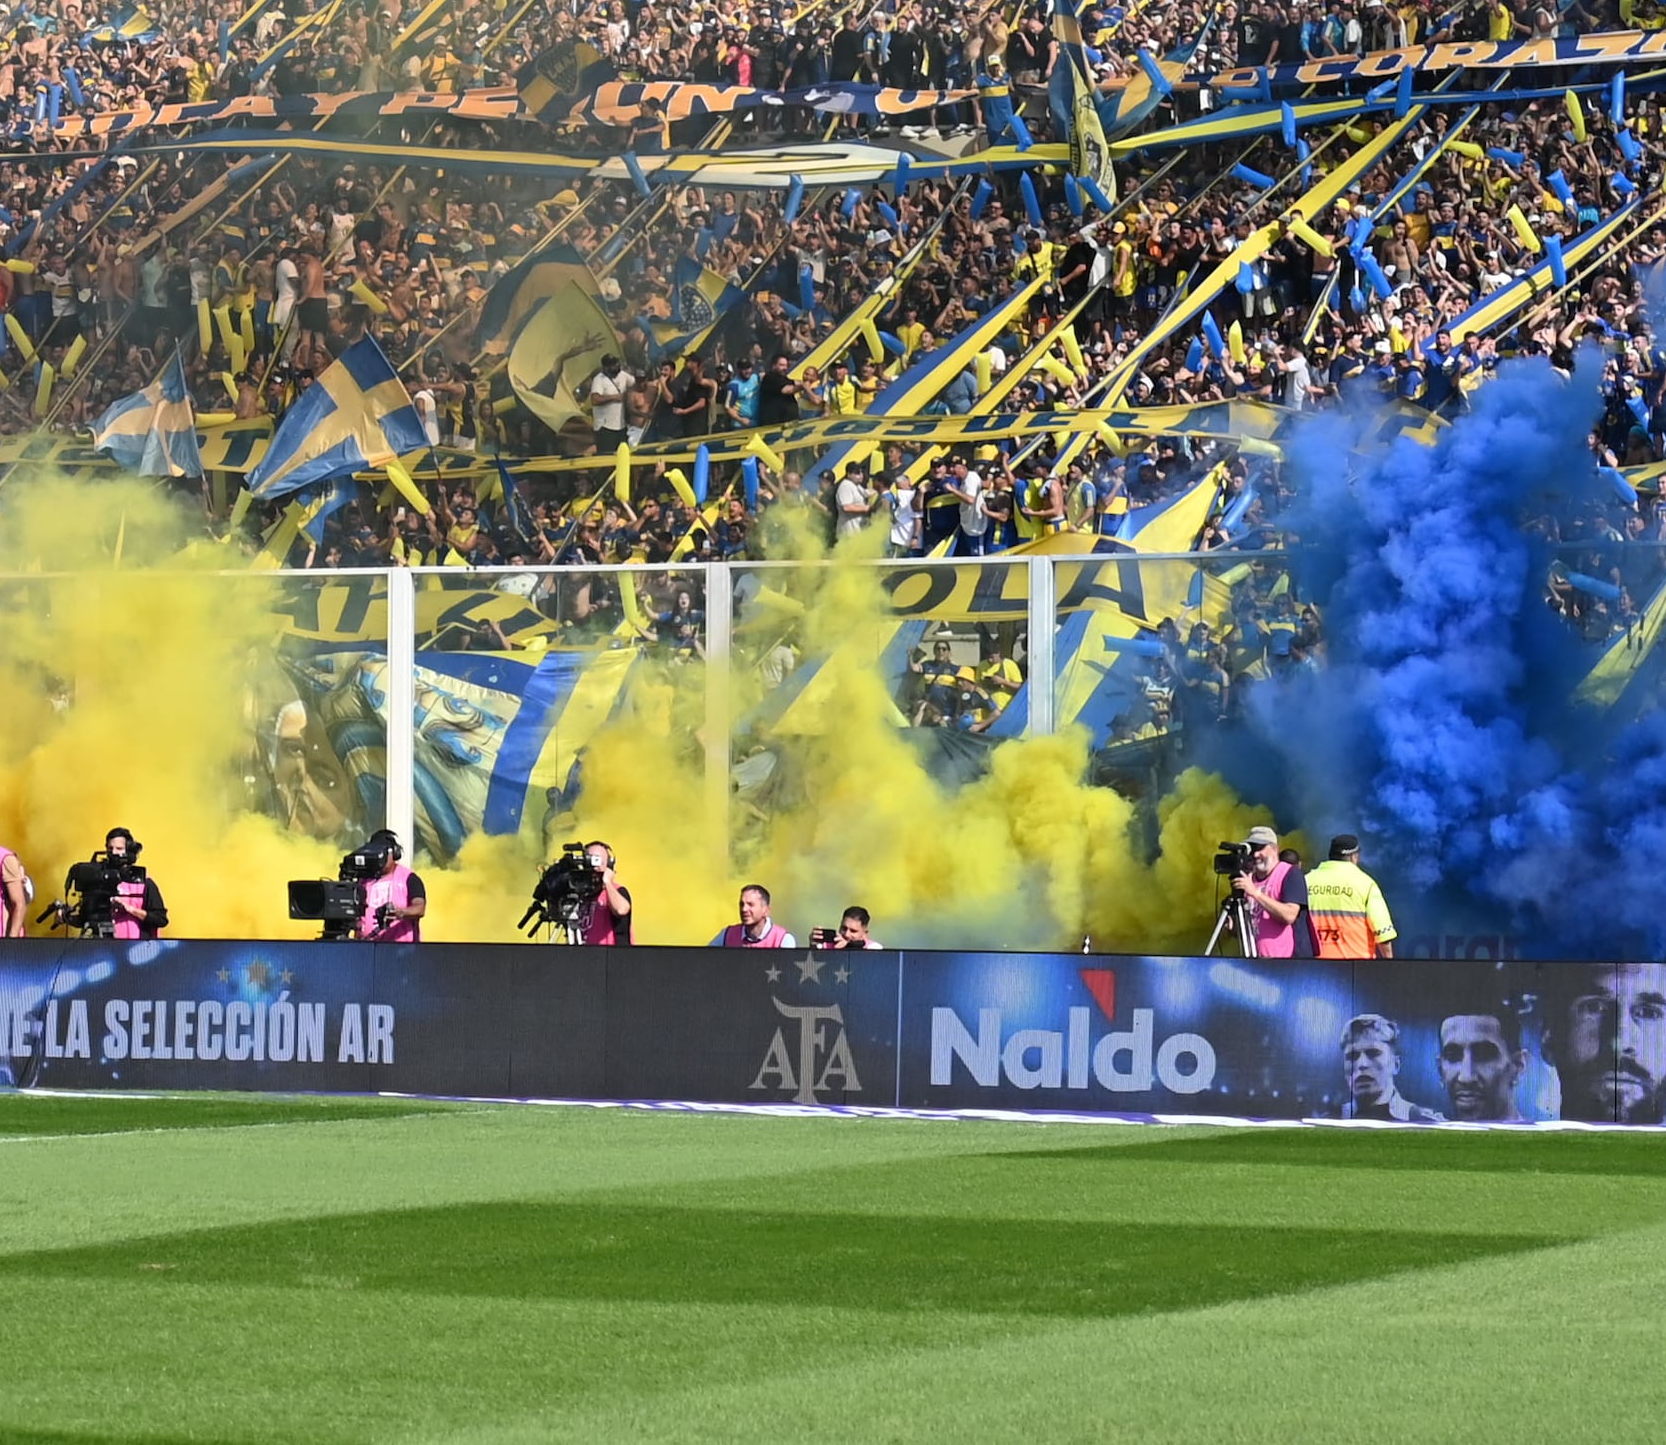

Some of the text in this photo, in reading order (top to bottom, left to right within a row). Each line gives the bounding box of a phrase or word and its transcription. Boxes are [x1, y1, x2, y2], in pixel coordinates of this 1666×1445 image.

[45, 999, 89, 1059] LA
[103, 991, 325, 1063] SELECCIÓN
[338, 1003, 396, 1064] AR
[930, 1006, 1217, 1095] Naldo
